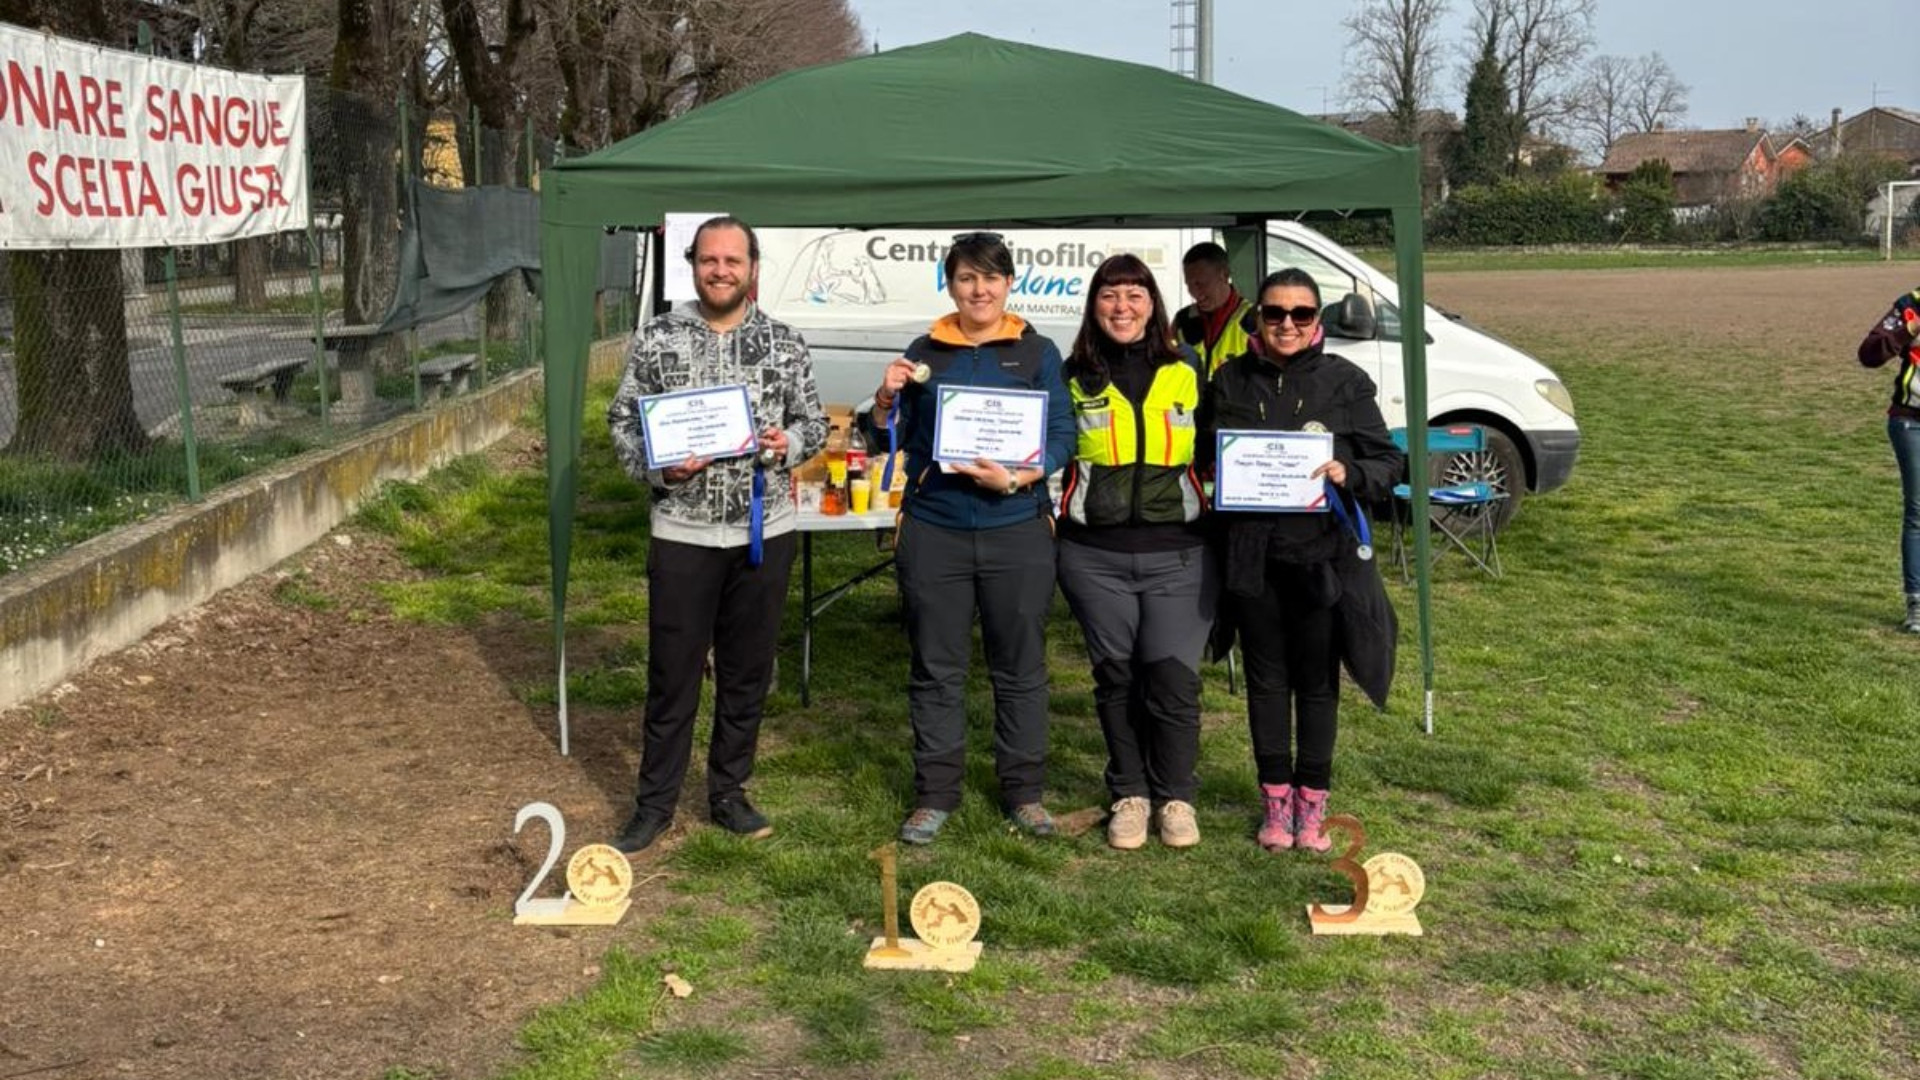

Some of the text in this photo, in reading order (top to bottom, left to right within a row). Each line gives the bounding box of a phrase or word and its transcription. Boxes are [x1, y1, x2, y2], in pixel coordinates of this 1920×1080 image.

[146, 84, 290, 148] SANGUE
[27, 151, 290, 217] SCELTA GIUSTA
[866, 236, 951, 263] Centr
[1010, 263, 1083, 296] done
[1006, 303, 1082, 316] AM MANTRAIL
[514, 802, 571, 915] 2
[1311, 814, 1369, 923] 3
[868, 841, 912, 957] 1
